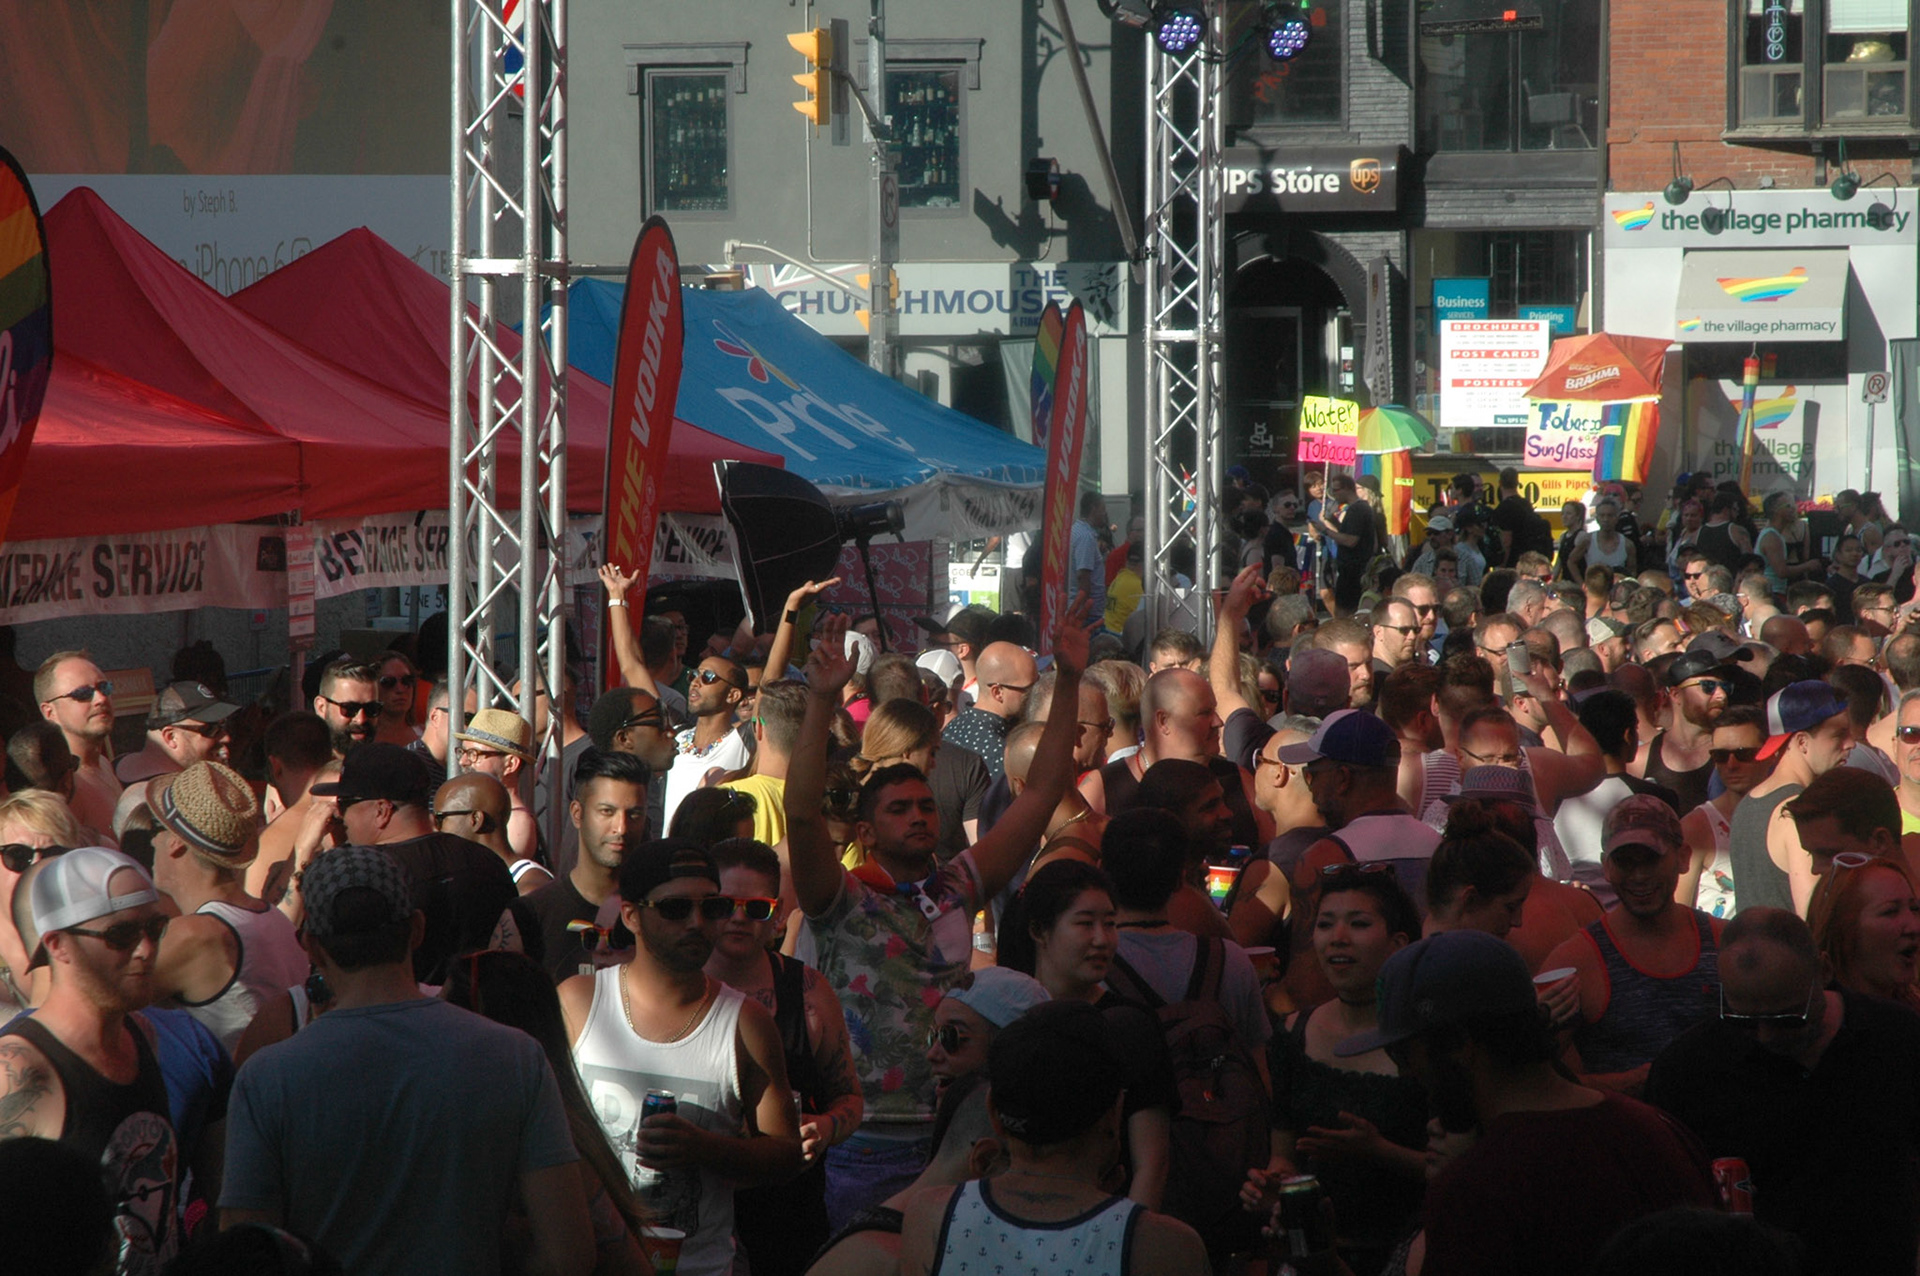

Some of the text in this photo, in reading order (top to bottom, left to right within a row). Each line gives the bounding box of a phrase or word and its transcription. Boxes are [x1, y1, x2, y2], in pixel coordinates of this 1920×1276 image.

[1270, 166, 1340, 194] Store
[1352, 168, 1378, 188] ups
[183, 190, 196, 218] by
[199, 191, 226, 217] Steph
[1661, 207, 1911, 234] the village pharmacy
[1016, 270, 1068, 286] THE
[776, 289, 1069, 314] CHUHMOUSE
[1437, 296, 1485, 308] Business
[1453, 323, 1535, 331] BROCHURES
[1529, 311, 1564, 323] Printing
[1704, 321, 1836, 333] the village pharmacy
[1565, 366, 1621, 390] BRAHMA
[614, 246, 675, 565] THE VODKA
[1303, 402, 1354, 429] Water
[1301, 435, 1357, 462] Tobacco
[1713, 458, 1814, 478] phrmacy
[404, 592, 429, 608] ZNE
